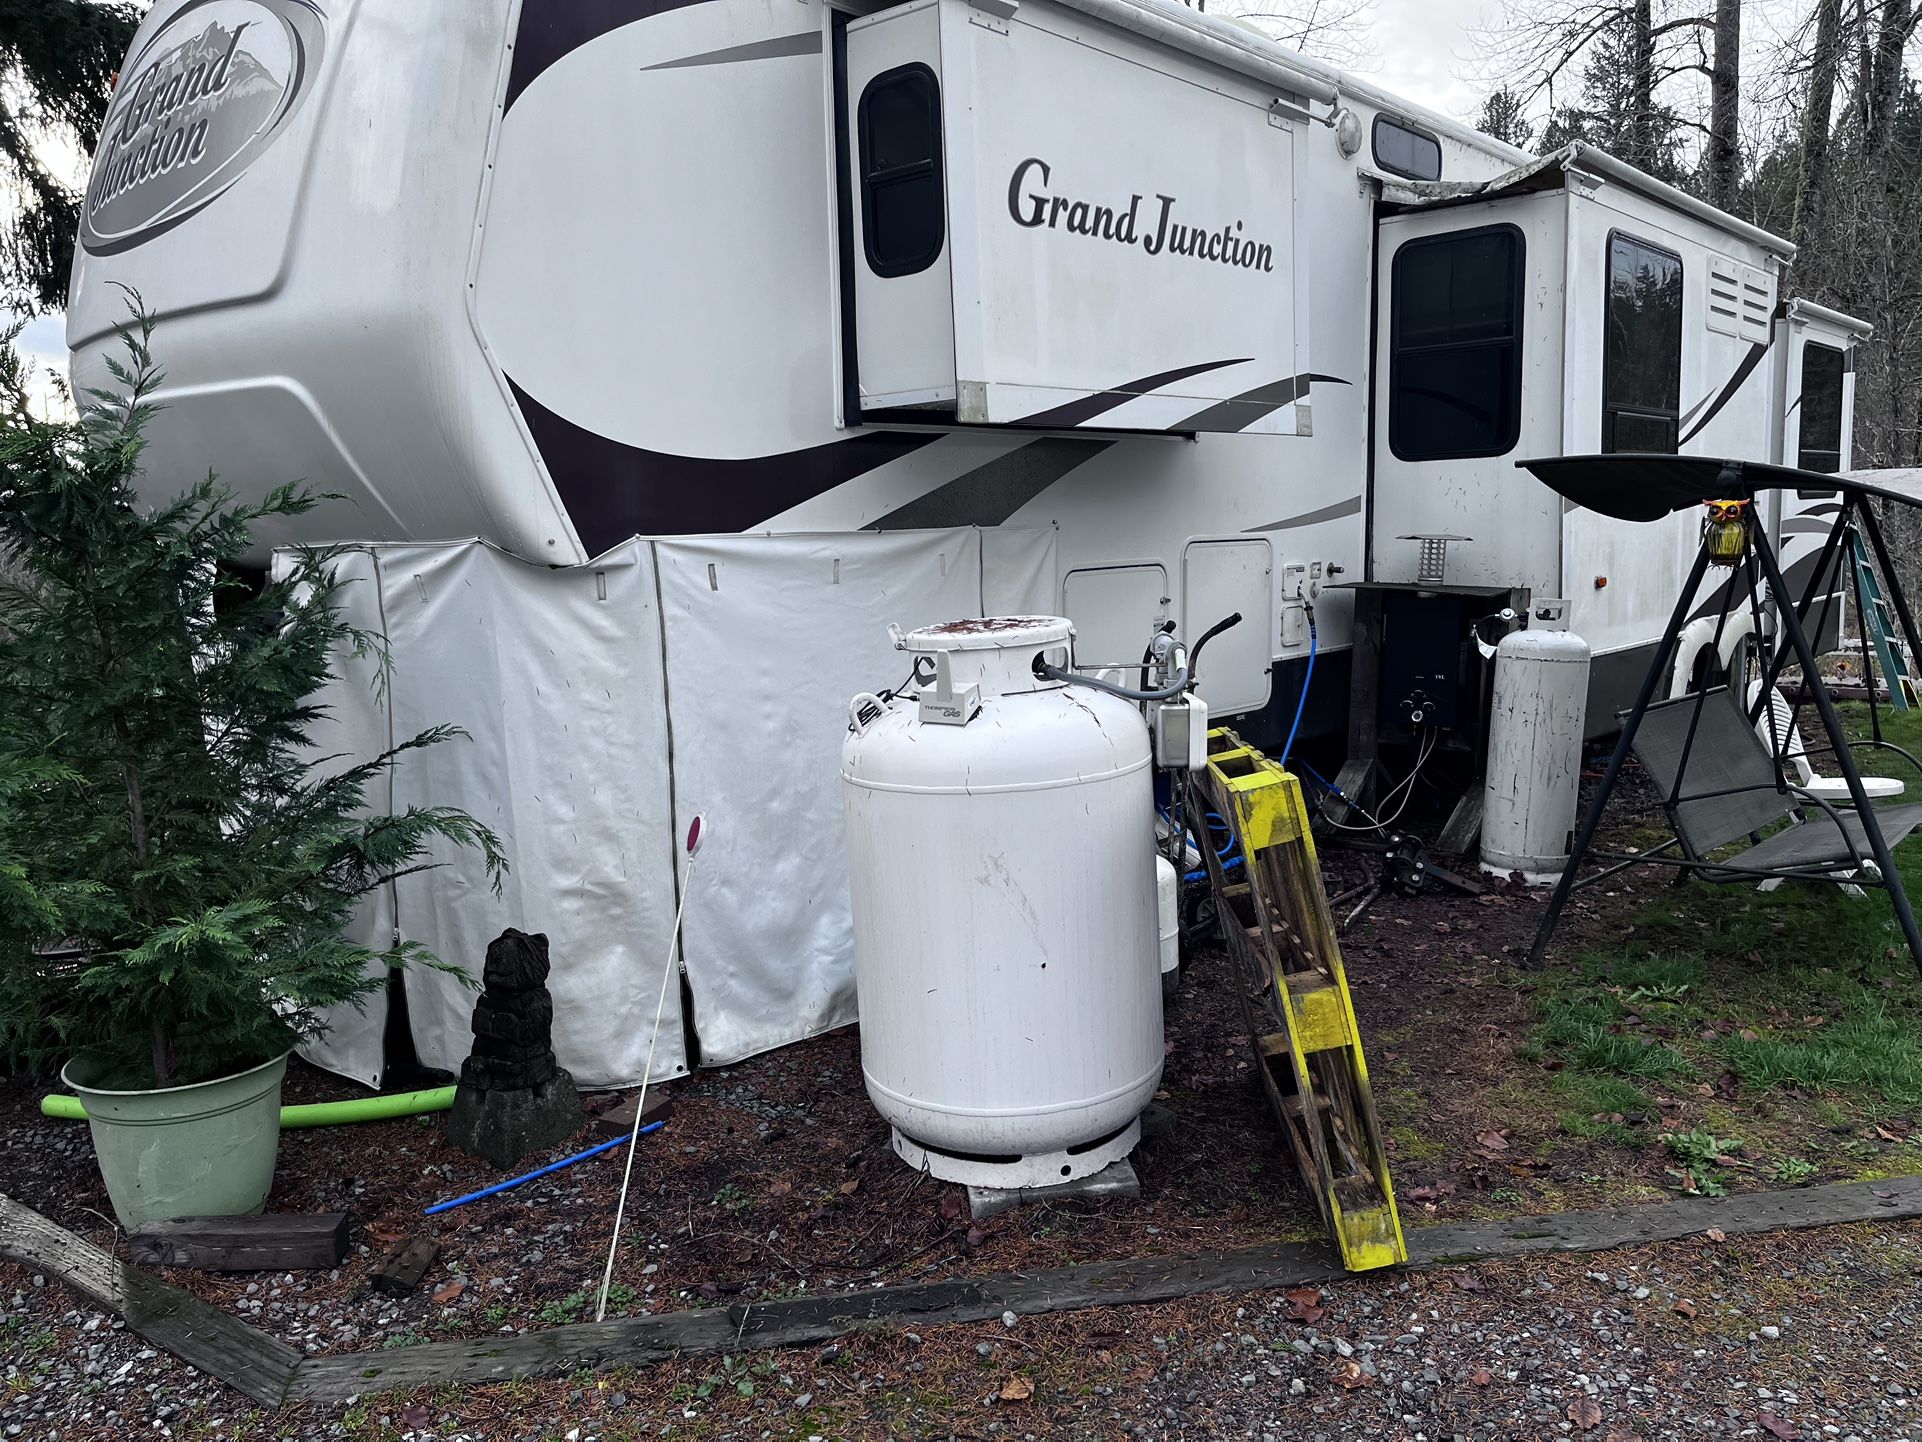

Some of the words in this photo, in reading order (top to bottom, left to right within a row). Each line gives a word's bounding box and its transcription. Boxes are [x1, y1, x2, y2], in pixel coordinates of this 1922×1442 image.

[119, 20, 251, 149] Grand
[92, 117, 210, 216] Junction
[1007, 157, 1143, 245] Grand
[1143, 192, 1274, 273] Junction
[943, 710, 961, 718] GAS
